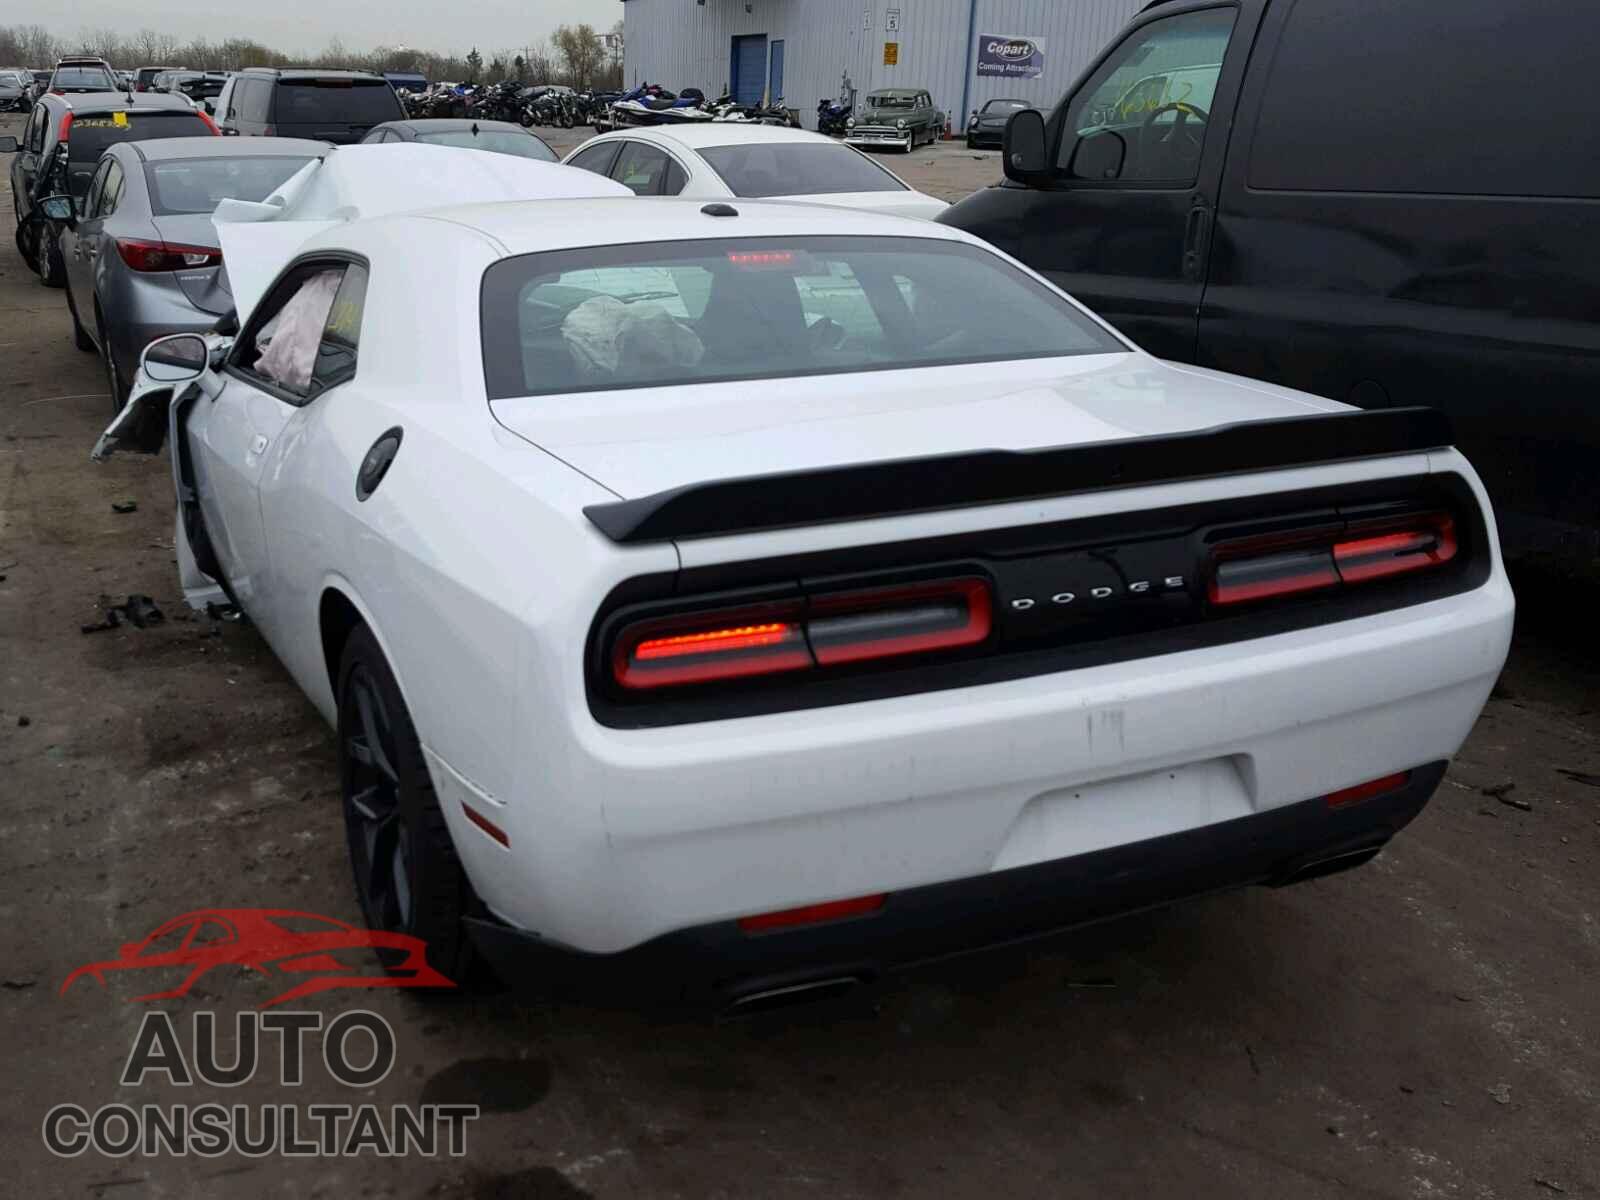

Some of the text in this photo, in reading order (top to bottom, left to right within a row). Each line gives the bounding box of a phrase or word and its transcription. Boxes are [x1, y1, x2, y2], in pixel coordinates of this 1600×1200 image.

[987, 42, 1029, 55] Copart
[978, 62, 1004, 72] Coming
[1011, 576, 1183, 609] DODGE
